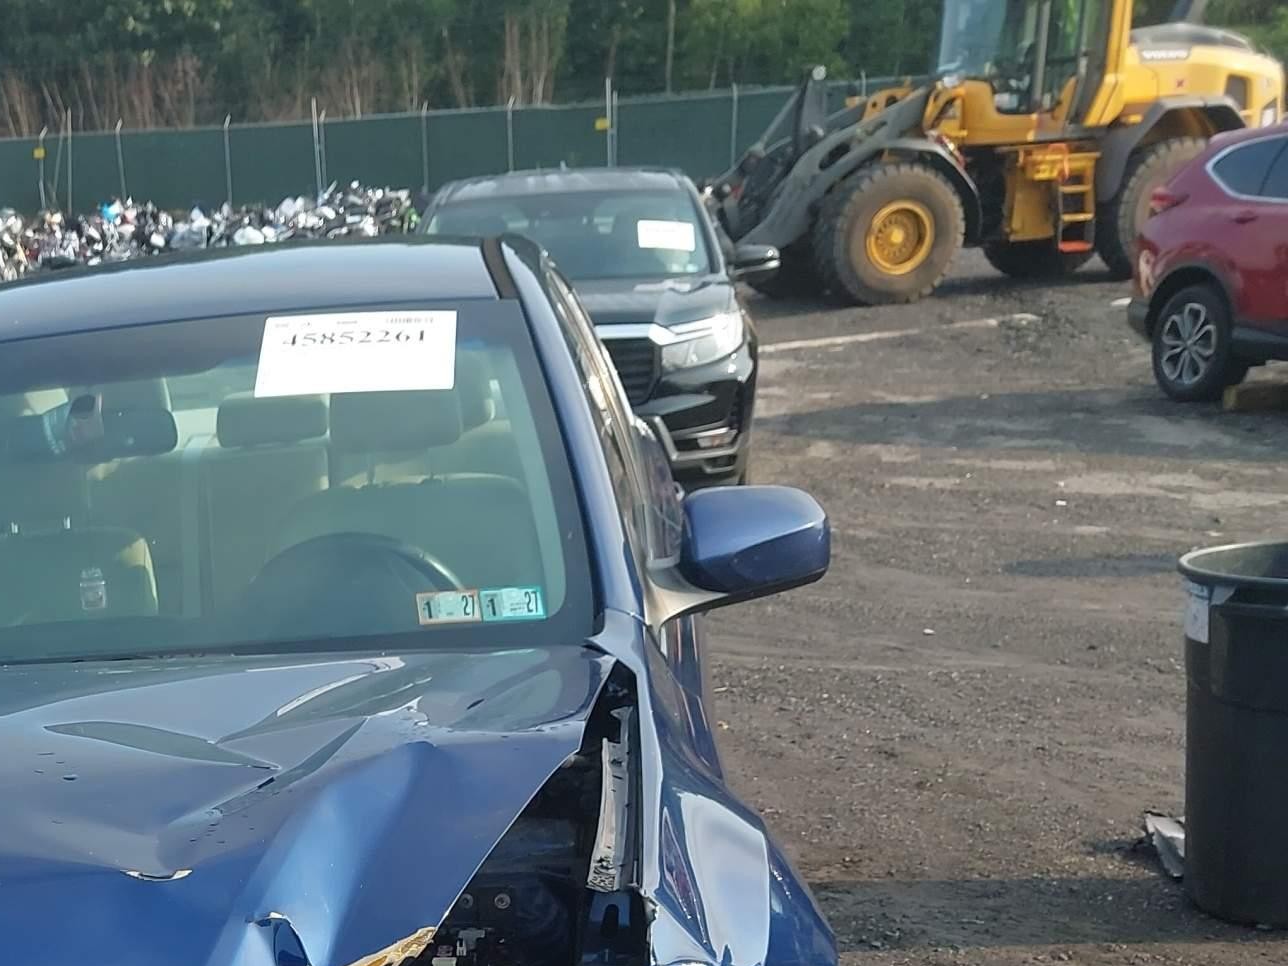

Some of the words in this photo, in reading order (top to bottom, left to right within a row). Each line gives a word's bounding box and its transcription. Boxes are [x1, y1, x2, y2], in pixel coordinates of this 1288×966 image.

[282, 329, 425, 347] 45852261
[462, 595, 475, 616] 27
[525, 591, 538, 613] 27
